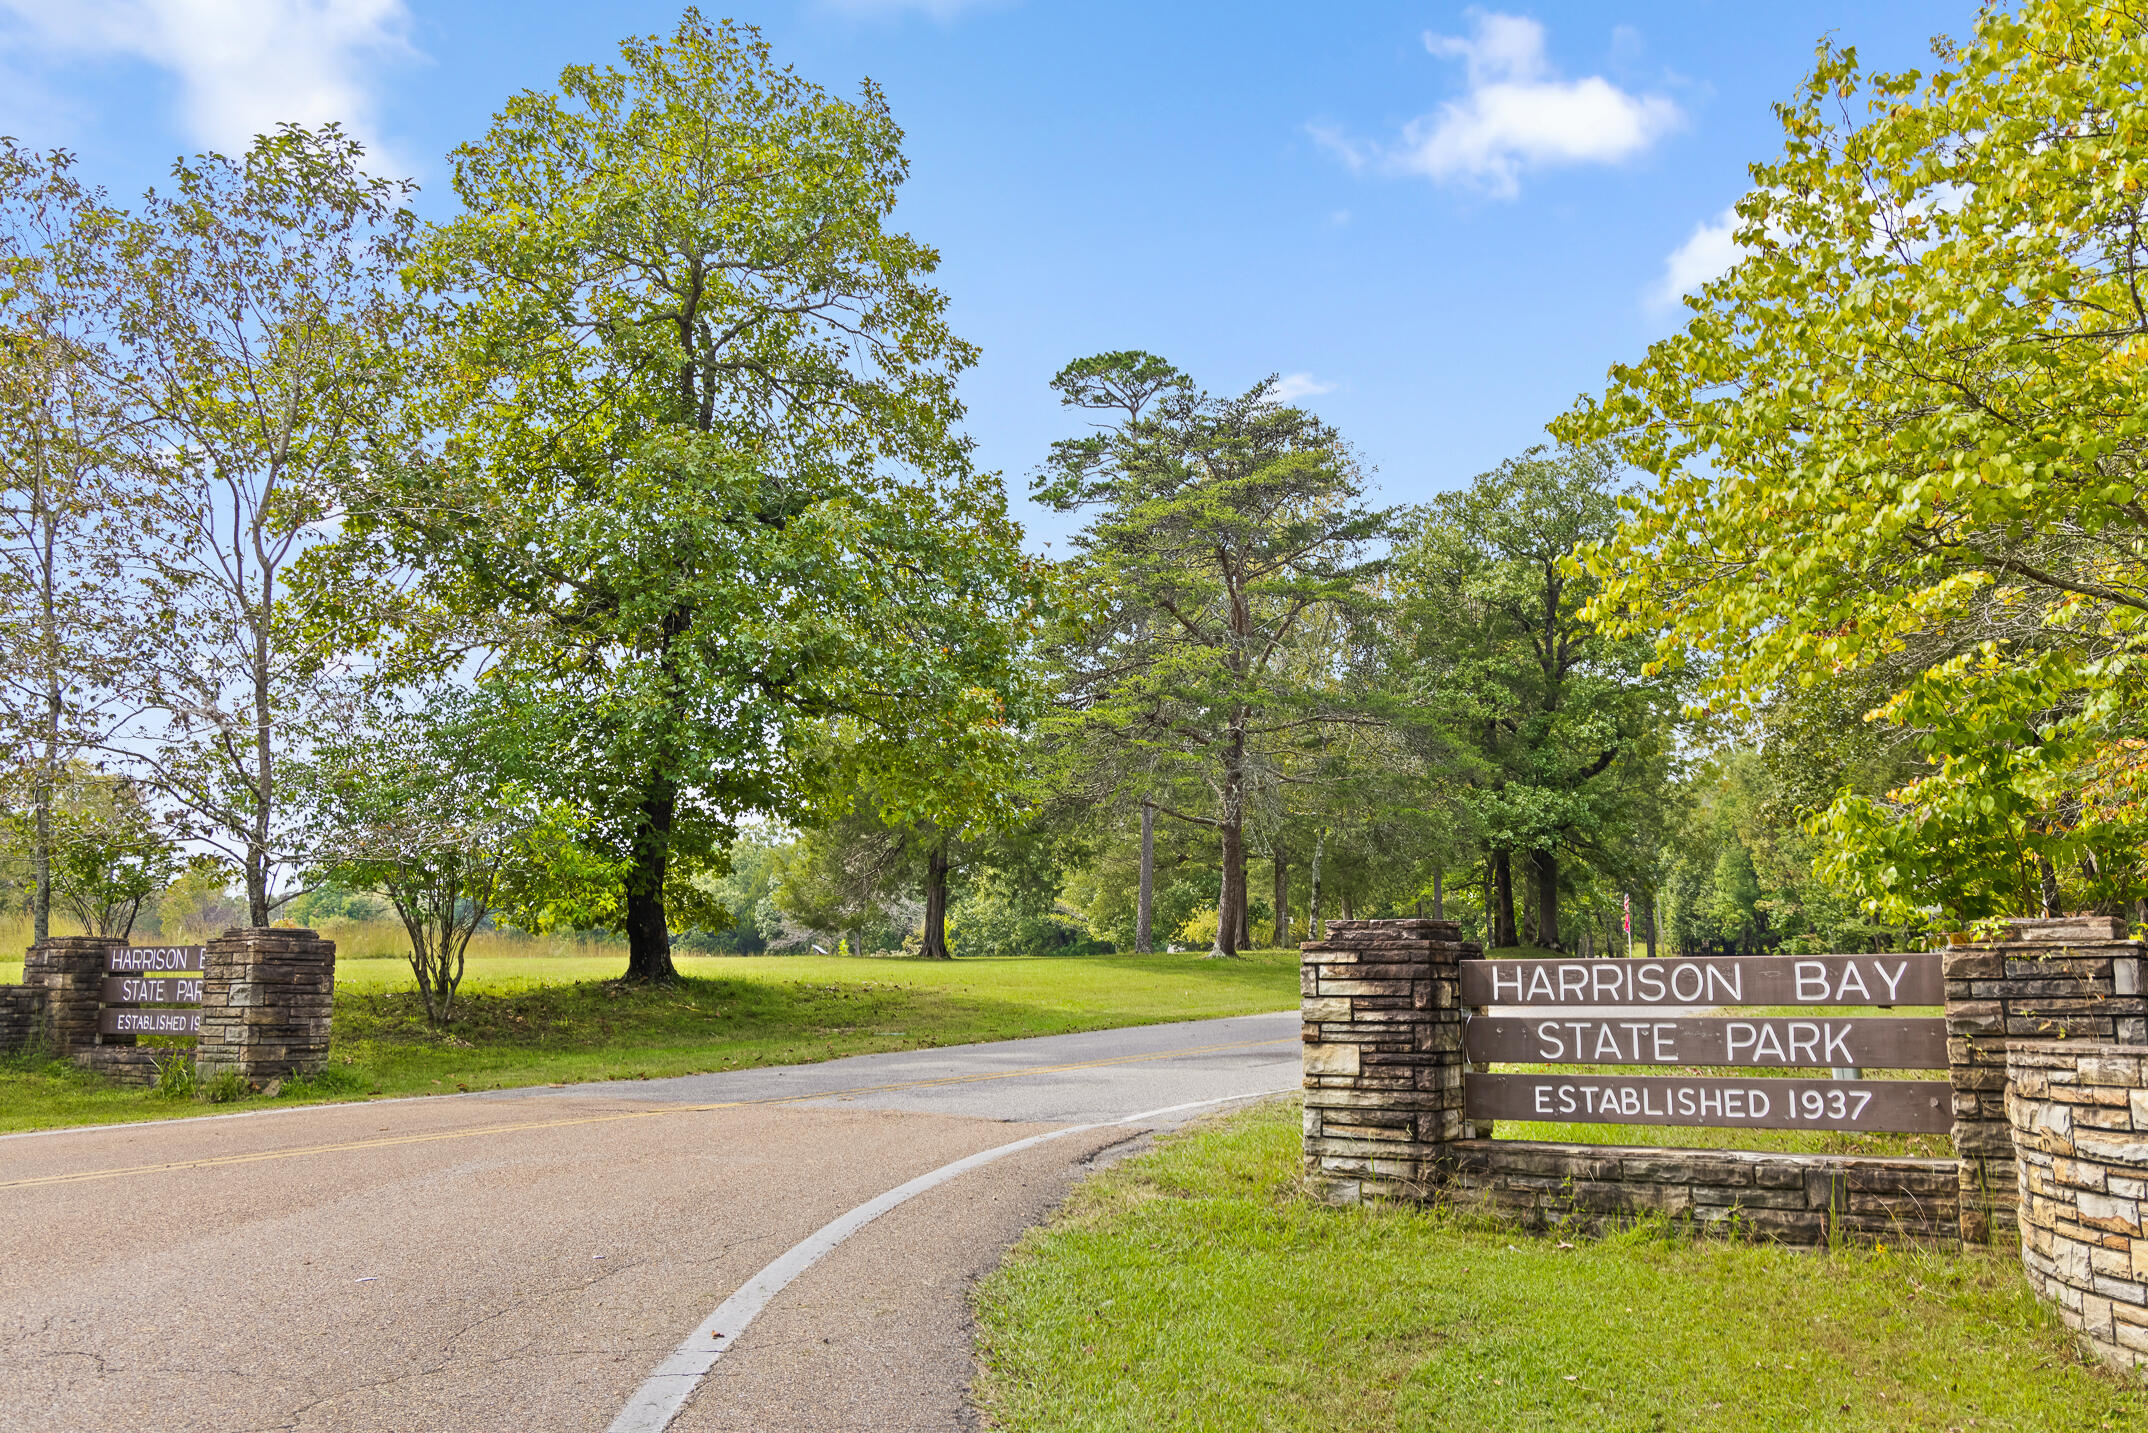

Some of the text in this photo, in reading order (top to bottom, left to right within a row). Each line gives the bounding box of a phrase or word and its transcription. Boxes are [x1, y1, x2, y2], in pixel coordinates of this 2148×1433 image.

[112, 949, 187, 970] HARRISON
[123, 980, 203, 1001] STATE PAR
[1492, 960, 1909, 1001] HARRISON BAY
[117, 1014, 200, 1031] ESTABLISHED 19
[1537, 1021, 1854, 1064] STATE PARK
[1534, 1085, 1873, 1121] ESTABLISHED 1937
